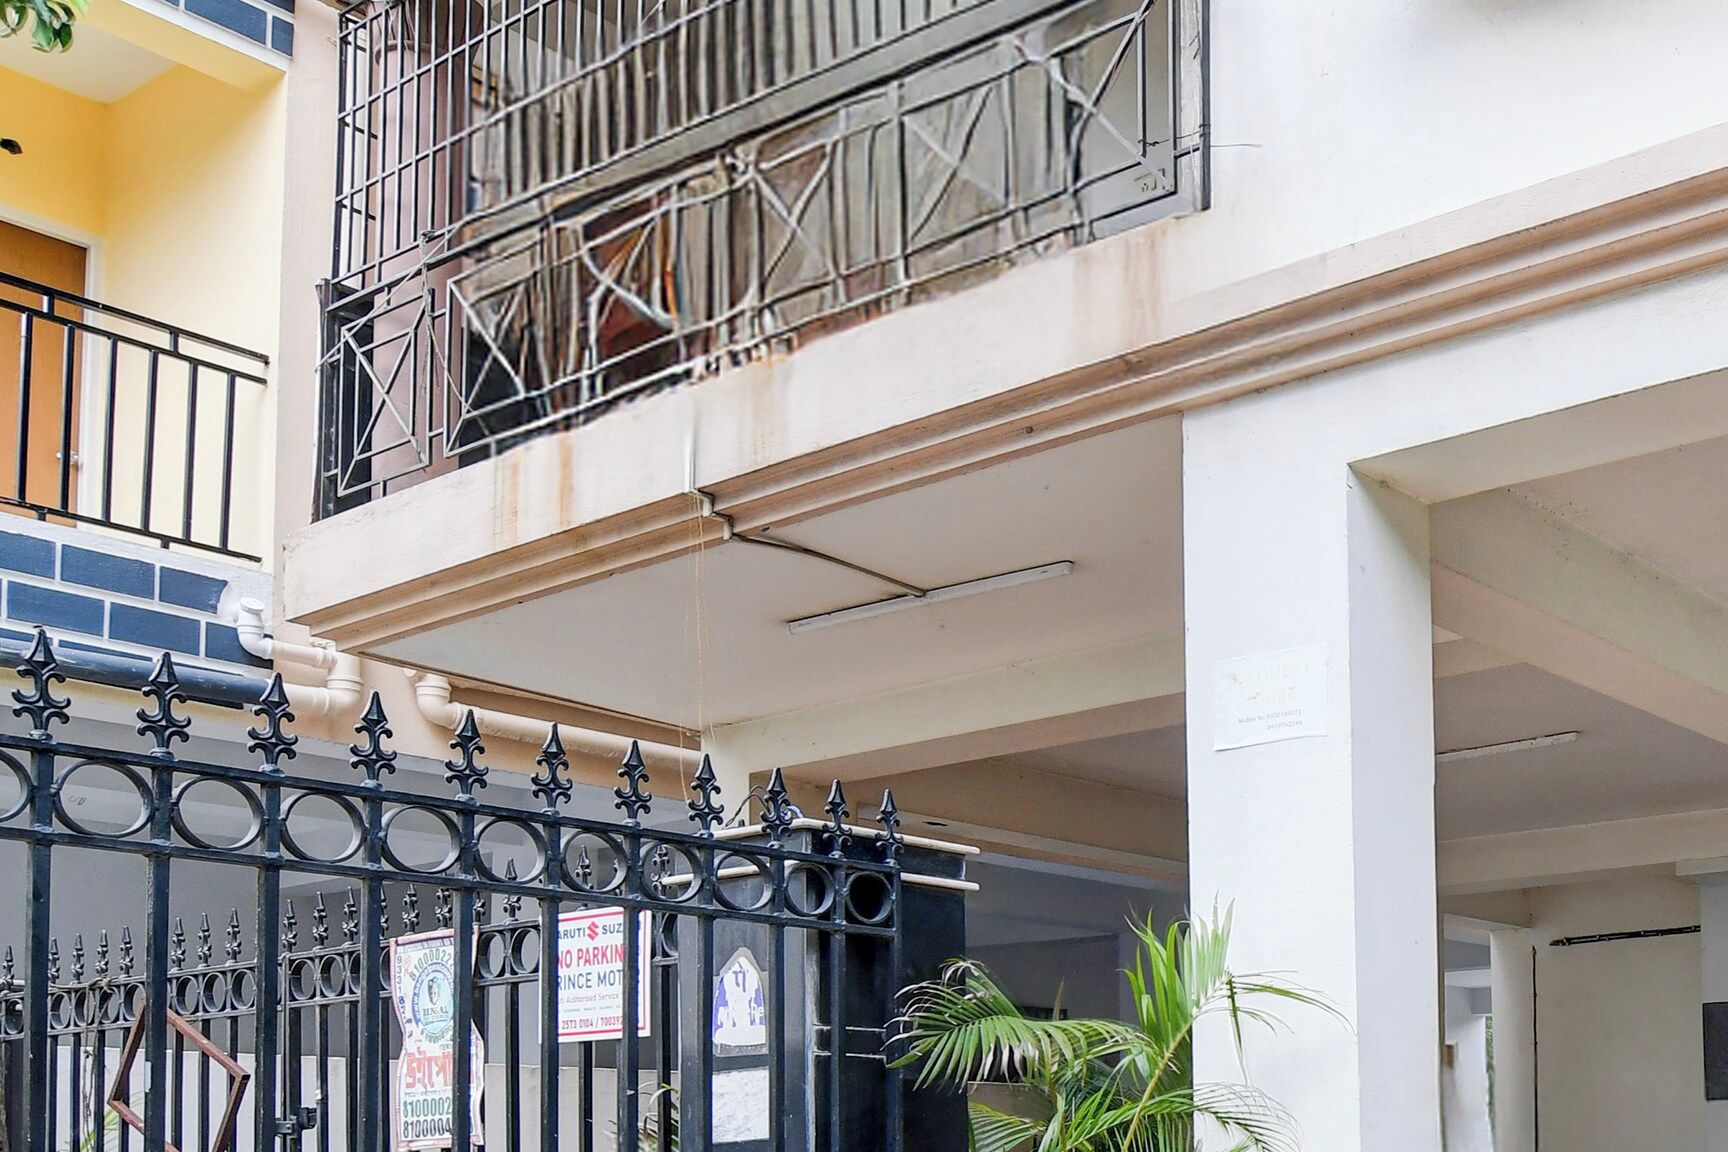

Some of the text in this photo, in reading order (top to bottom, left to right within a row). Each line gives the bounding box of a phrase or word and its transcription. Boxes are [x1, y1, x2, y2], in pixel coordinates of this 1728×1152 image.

[558, 923, 623, 940] ARUTI SUZ
[558, 943, 625, 969] NO PARKIN
[558, 969, 624, 991] RINCE MOT
[403, 1097, 452, 1118] 8100002
